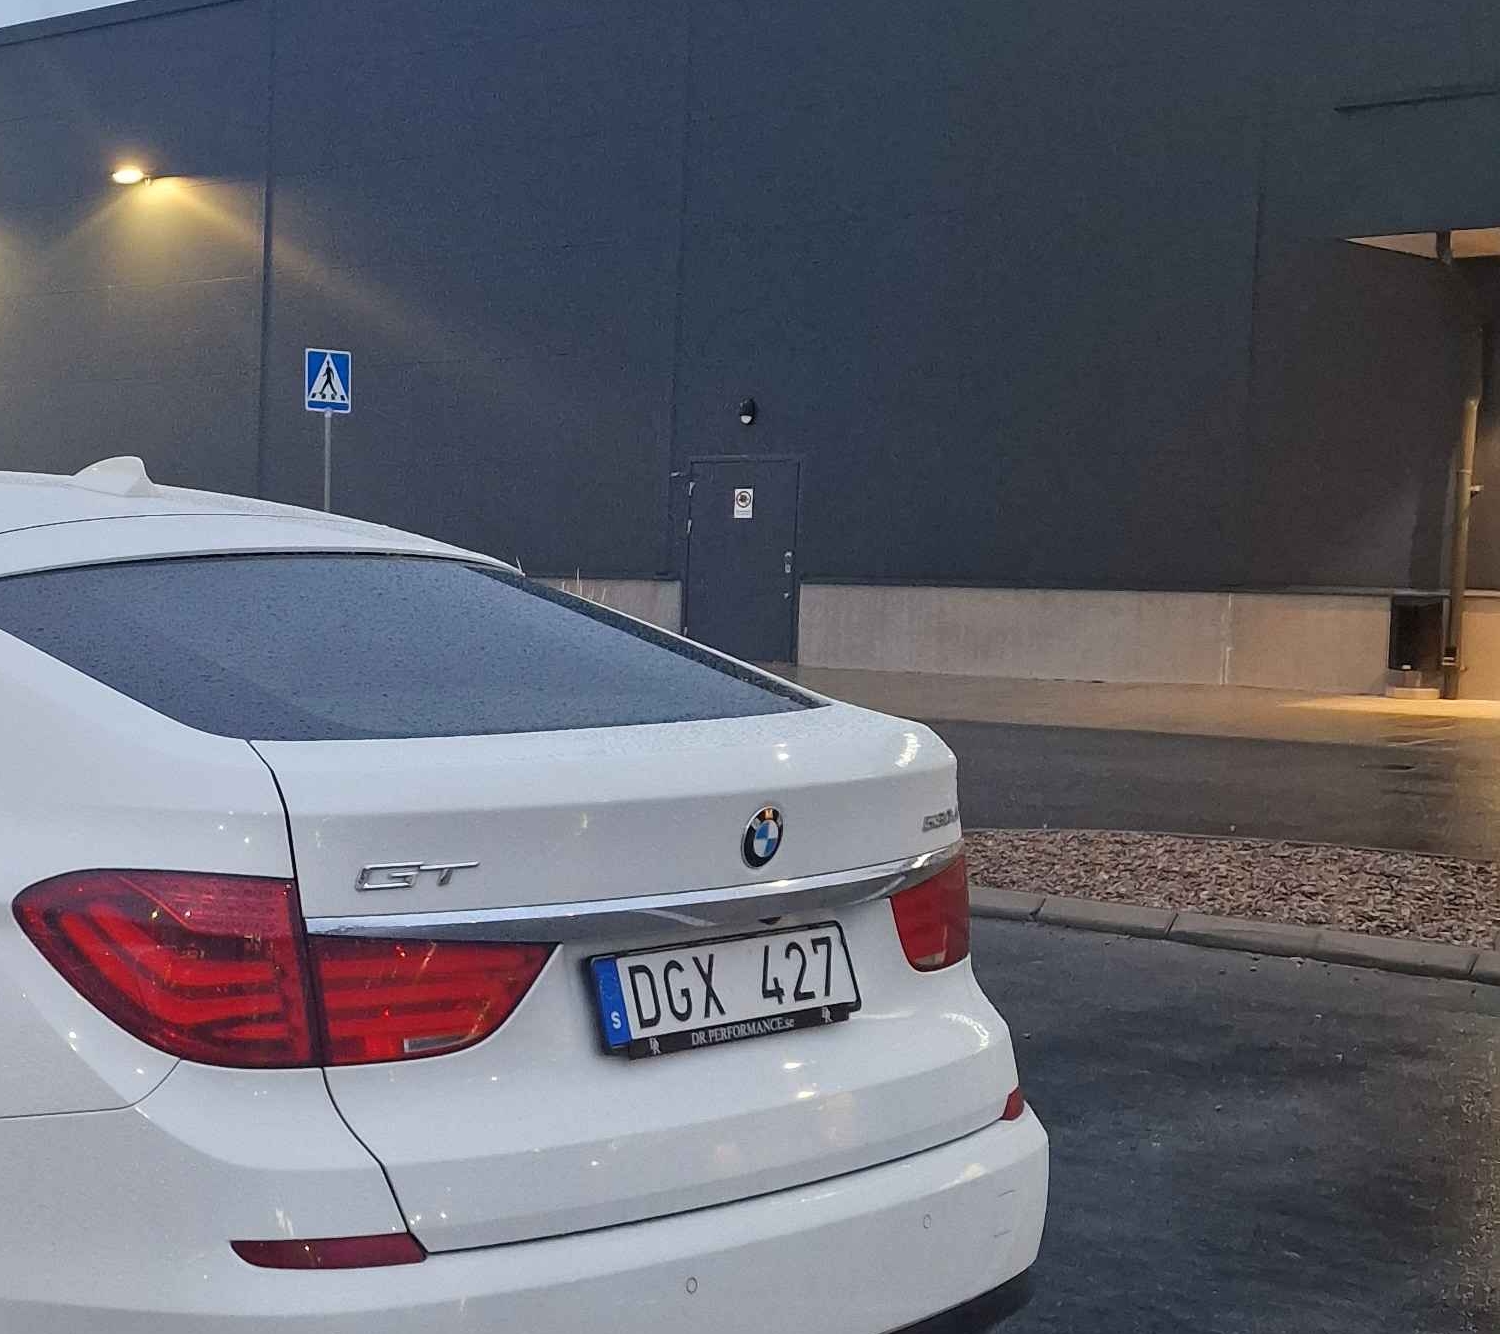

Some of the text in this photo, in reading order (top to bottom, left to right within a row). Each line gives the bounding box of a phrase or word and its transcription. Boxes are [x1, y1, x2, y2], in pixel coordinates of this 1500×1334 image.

[355, 860, 480, 892] GT
[628, 935, 833, 1029] DGX 427
[610, 1011, 622, 1030] S
[691, 1030, 708, 1046] DR
